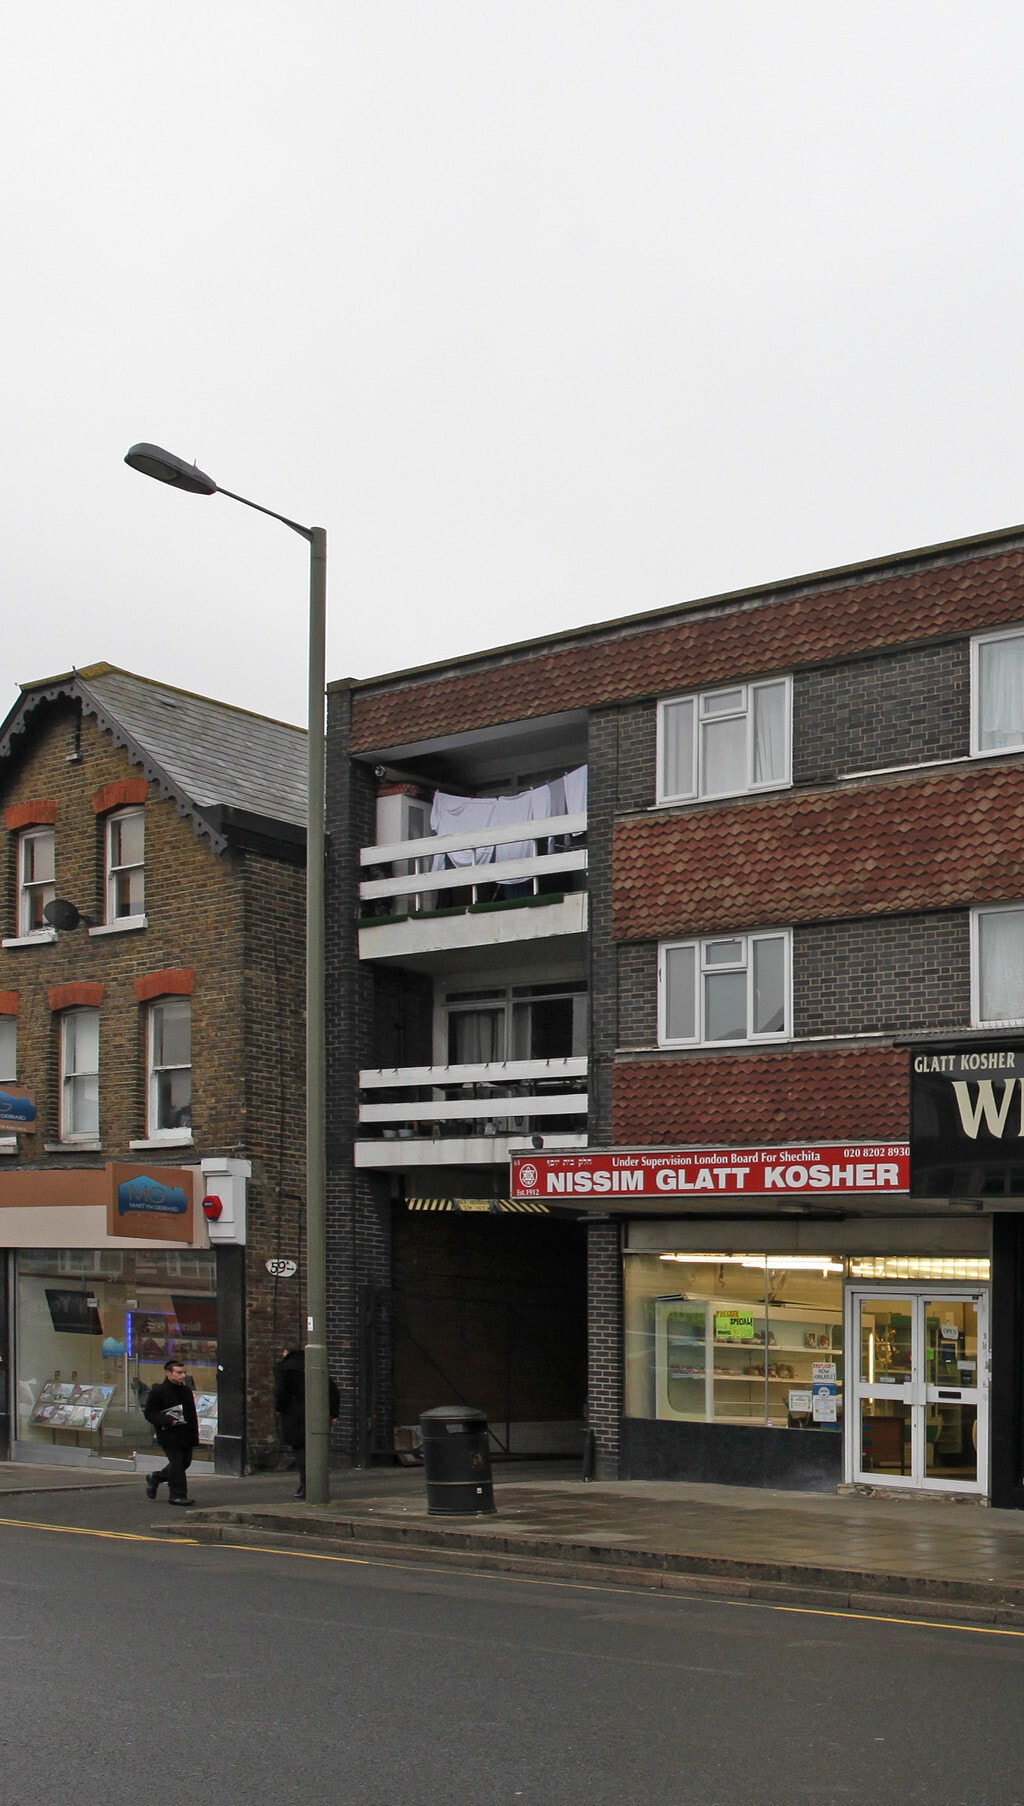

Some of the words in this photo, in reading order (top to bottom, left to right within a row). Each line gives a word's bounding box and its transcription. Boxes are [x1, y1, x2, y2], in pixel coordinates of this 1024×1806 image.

[914, 1055, 956, 1073] GLATT
[960, 1052, 1016, 1071] KOSHER
[612, 1156, 640, 1168] Under
[641, 1155, 692, 1168] Supervision
[695, 1153, 729, 1165] London
[730, 1152, 759, 1163] Board
[761, 1151, 777, 1163] For
[779, 1150, 821, 1162] Shechita
[843, 1148, 861, 1158] 020
[863, 1147, 886, 1158] 8202
[546, 1170, 644, 1193] NISSIM
[655, 1167, 750, 1190] GLATT
[765, 1163, 900, 1188] KOSHER
[129, 1184, 165, 1204] MG
[942, 1327, 957, 1335] OPEN
